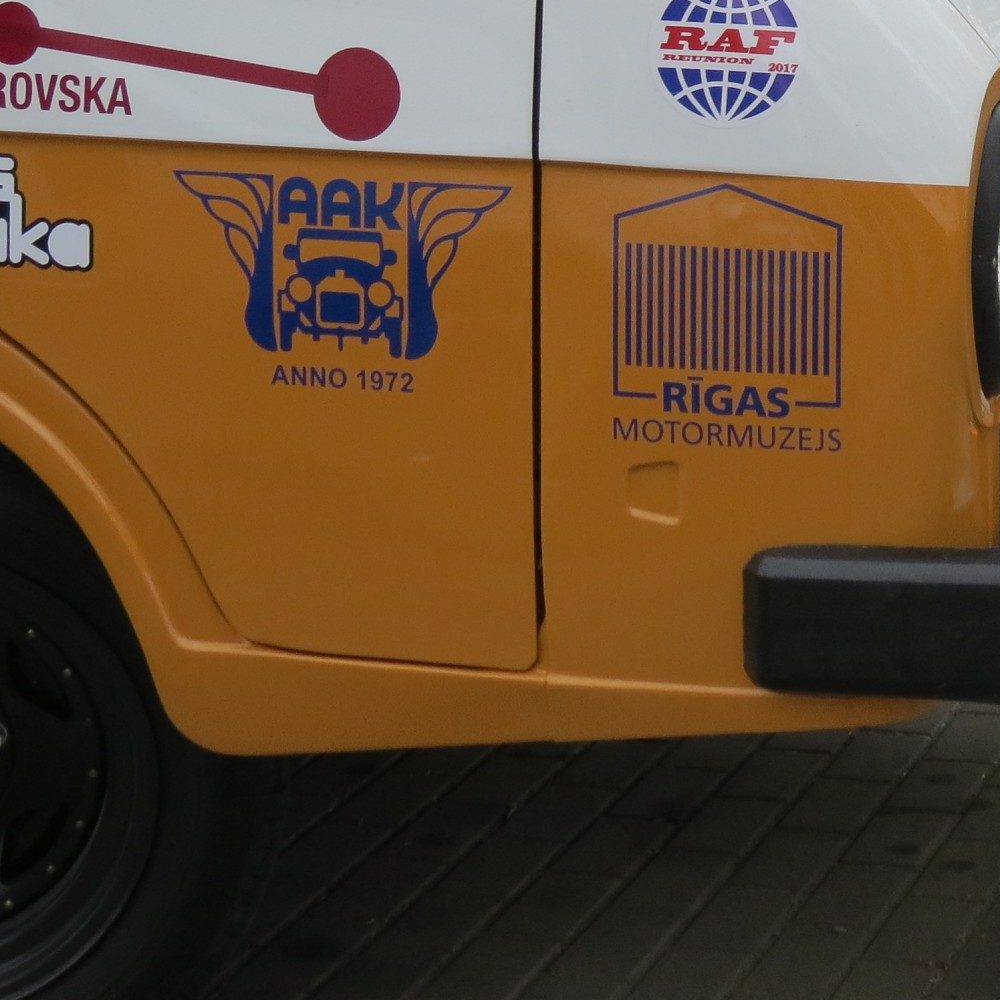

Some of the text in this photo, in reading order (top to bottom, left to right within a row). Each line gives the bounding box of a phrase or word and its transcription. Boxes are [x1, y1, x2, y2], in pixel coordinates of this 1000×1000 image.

[660, 25, 796, 55] RAF
[662, 54, 798, 73] REUNION 2017
[278, 176, 404, 231] AAK
[271, 365, 414, 393] ANNO 1972
[662, 376, 790, 418] RĪGAS
[613, 417, 842, 452] MOTORMUZEJS
